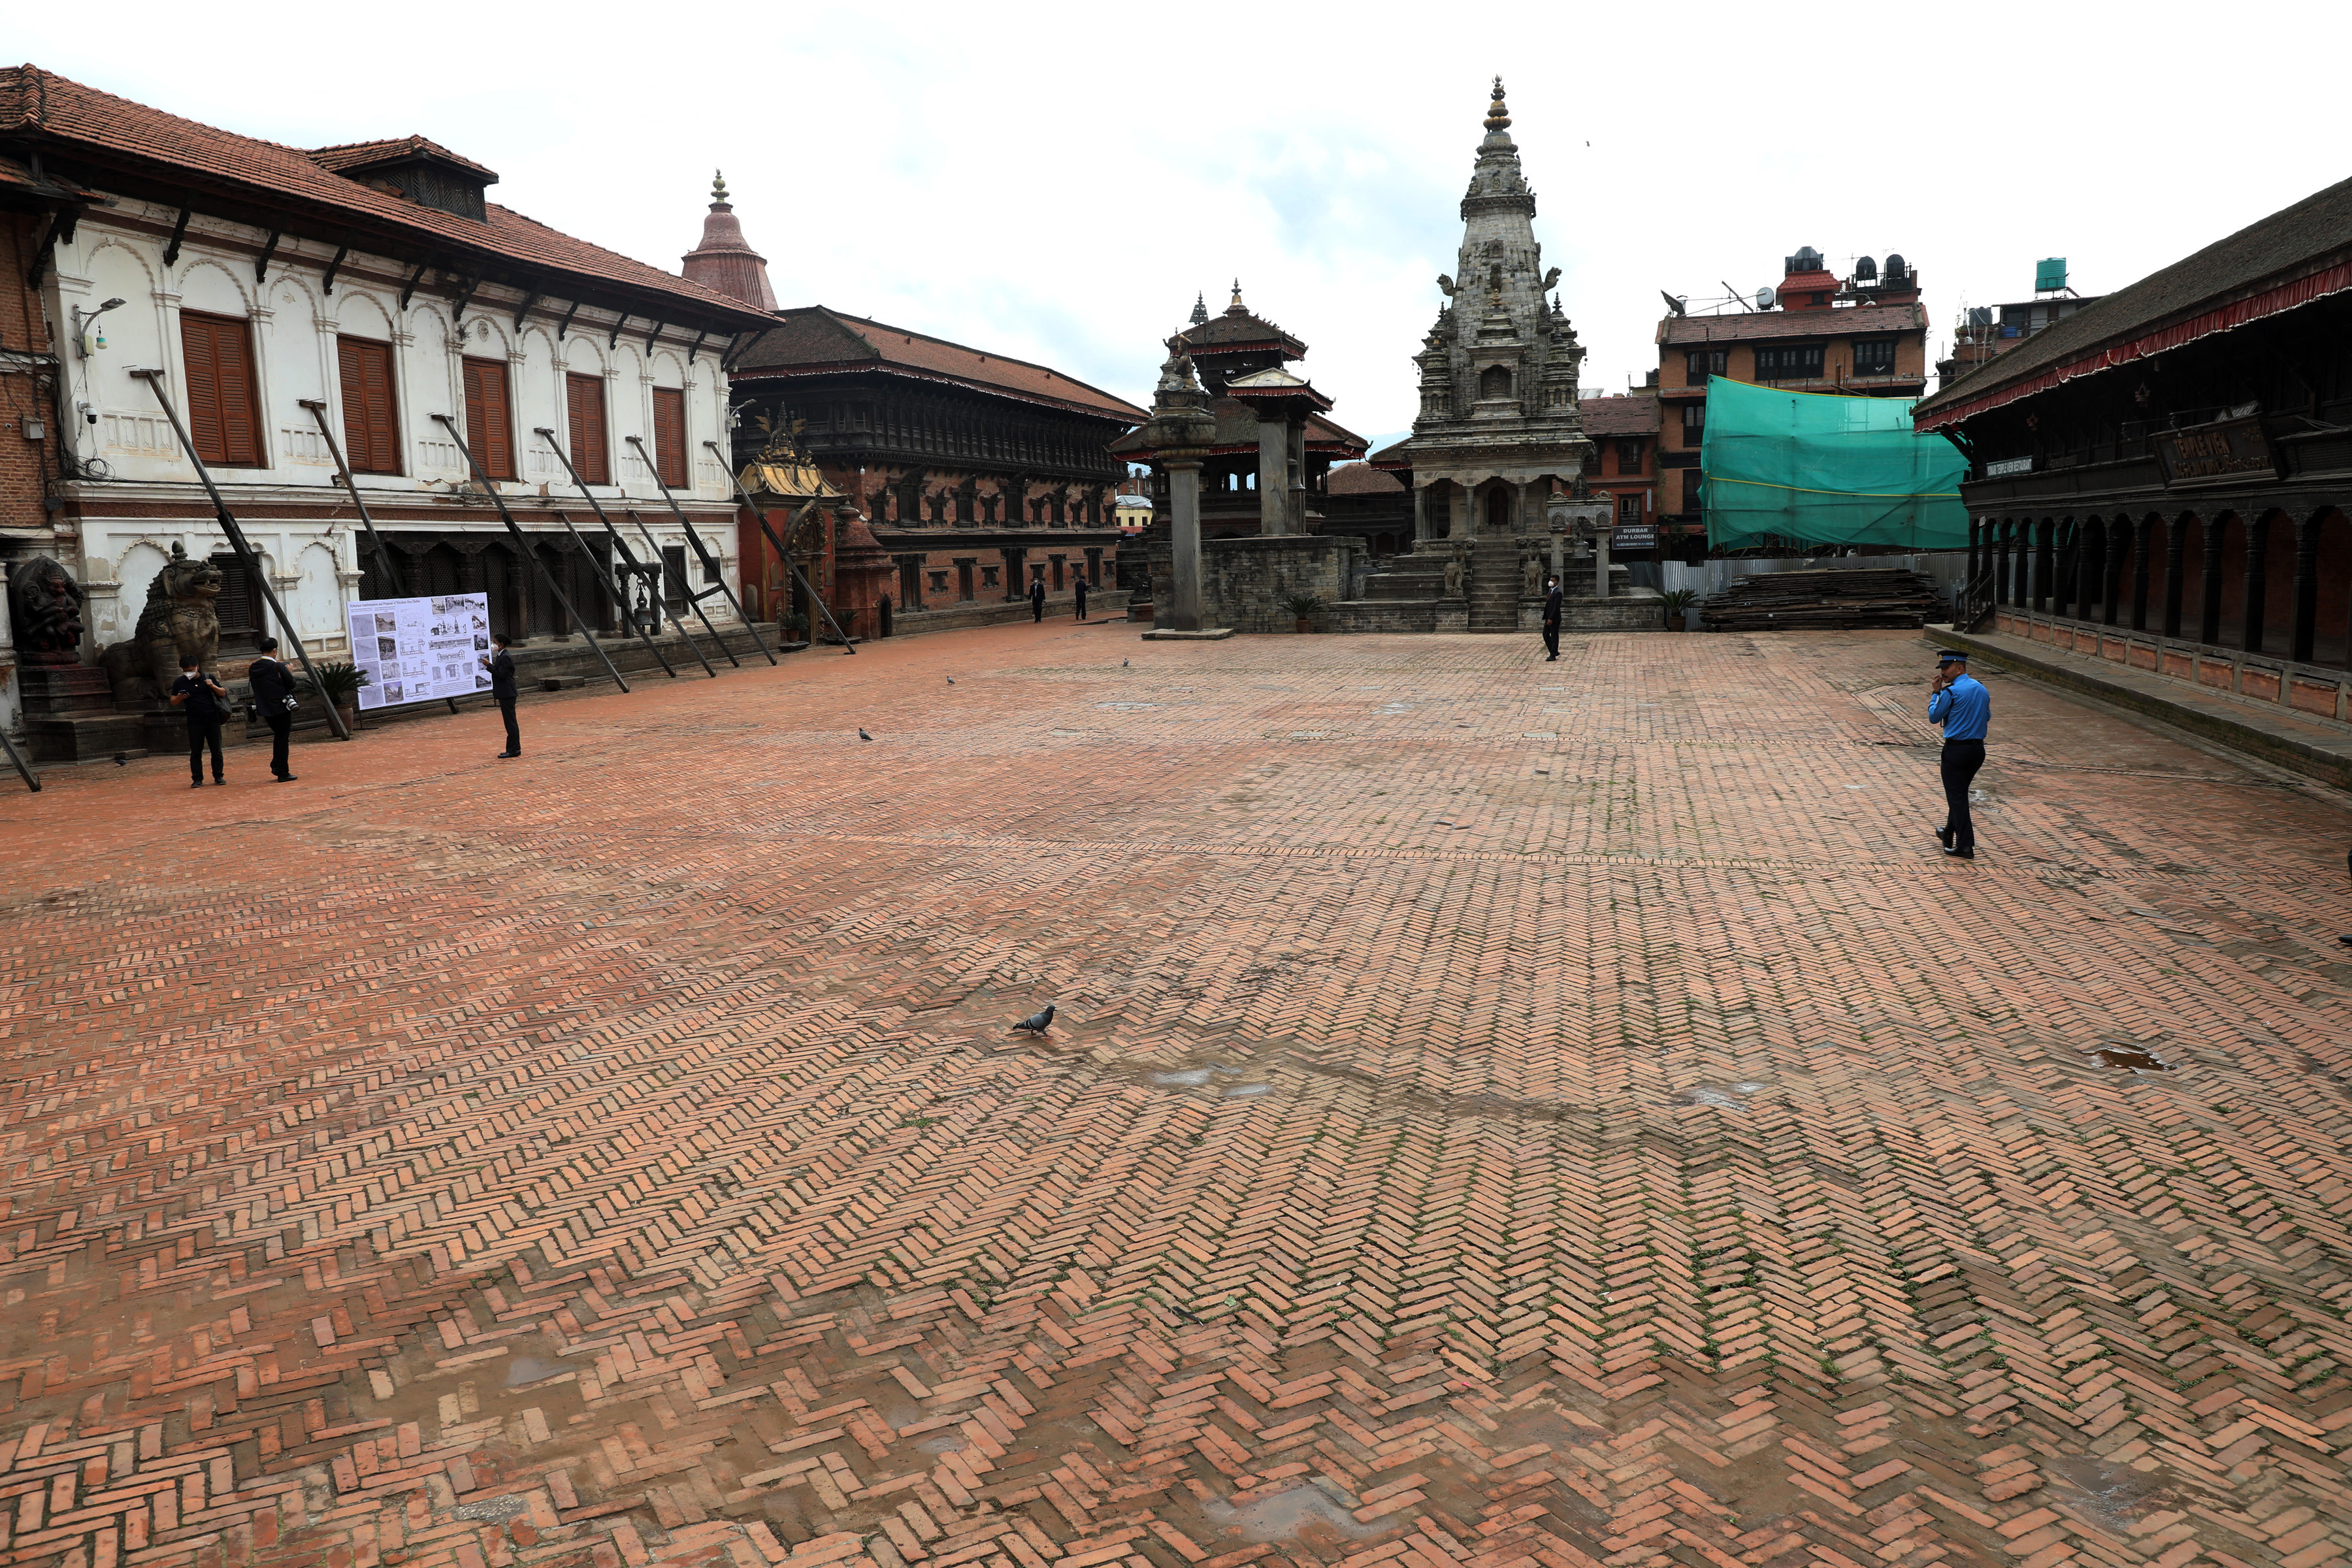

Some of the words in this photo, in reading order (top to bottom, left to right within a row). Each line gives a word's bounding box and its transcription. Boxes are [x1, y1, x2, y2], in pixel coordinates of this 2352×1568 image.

[2174, 436, 2208, 459] TEMPLE
[2204, 432, 2232, 455] VIEW
[1997, 462, 2007, 474] TEMPLE
[2014, 458, 2032, 472] RESTAURANT
